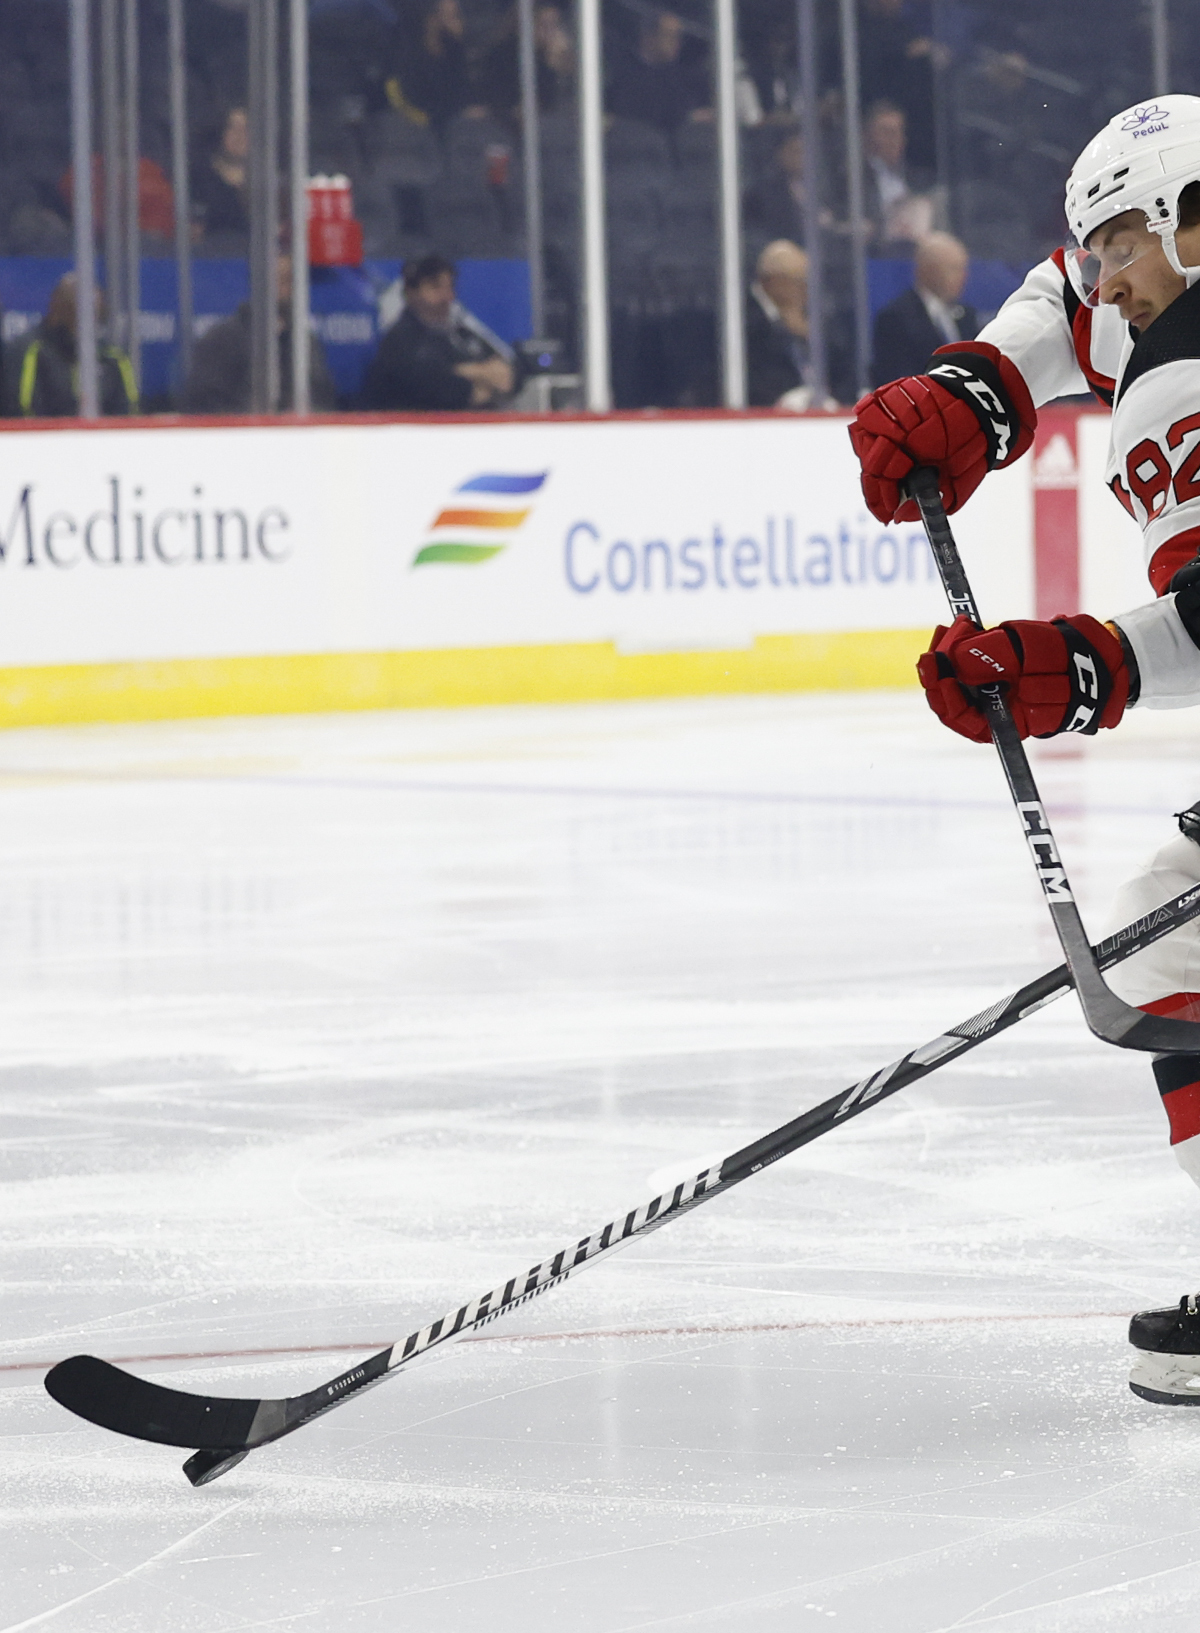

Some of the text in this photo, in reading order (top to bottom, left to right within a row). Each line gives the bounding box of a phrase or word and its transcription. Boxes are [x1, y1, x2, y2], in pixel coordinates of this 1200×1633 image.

[928, 364, 1012, 461] CCM
[565, 514, 938, 595] Constellation
[969, 647, 1005, 673] CCM
[1066, 651, 1098, 732] CC
[1018, 801, 1075, 903] CCM
[1096, 905, 1174, 959] LPHA
